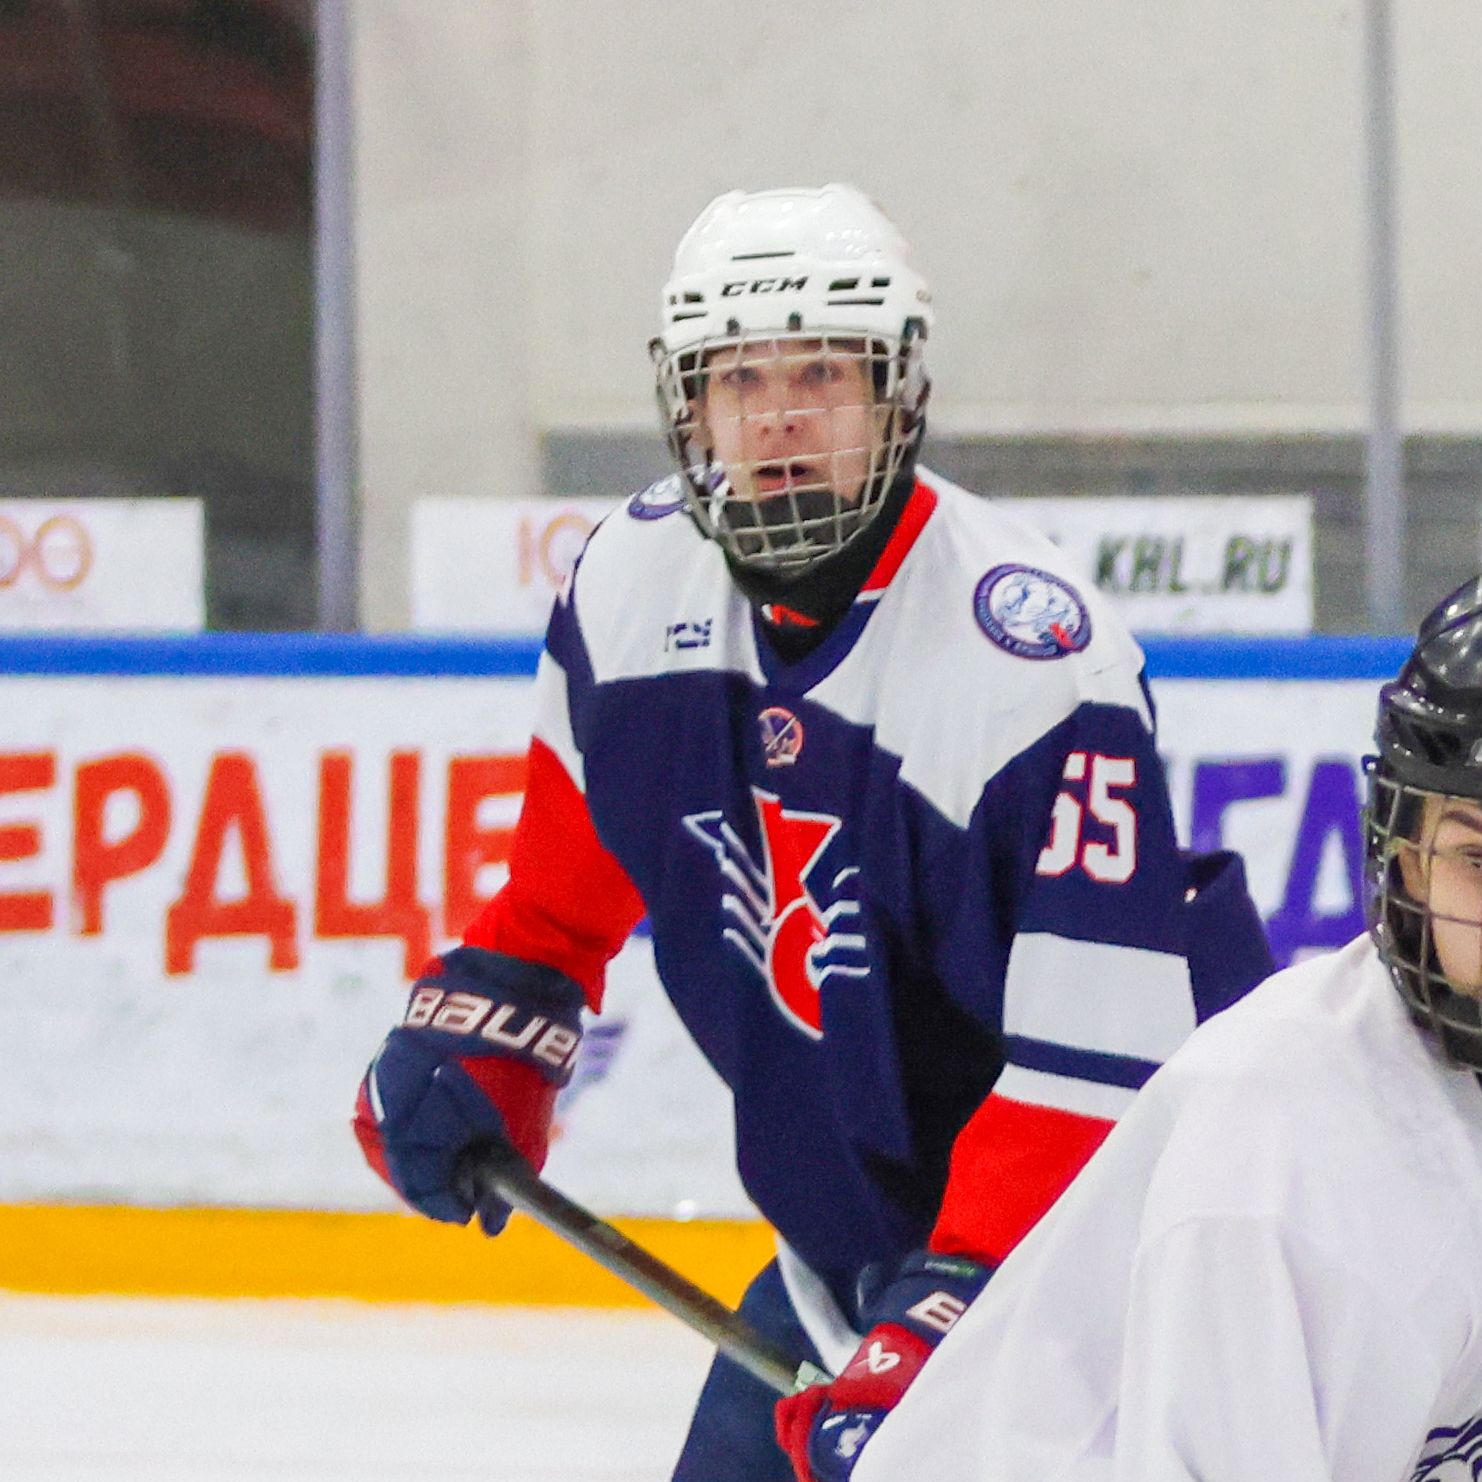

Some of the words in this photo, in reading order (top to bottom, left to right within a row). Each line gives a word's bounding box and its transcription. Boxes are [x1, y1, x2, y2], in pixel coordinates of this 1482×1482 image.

[720, 276, 810, 298] CCM
[1096, 534, 1293, 593] KHL.RU
[403, 986, 581, 1070] BAUE
